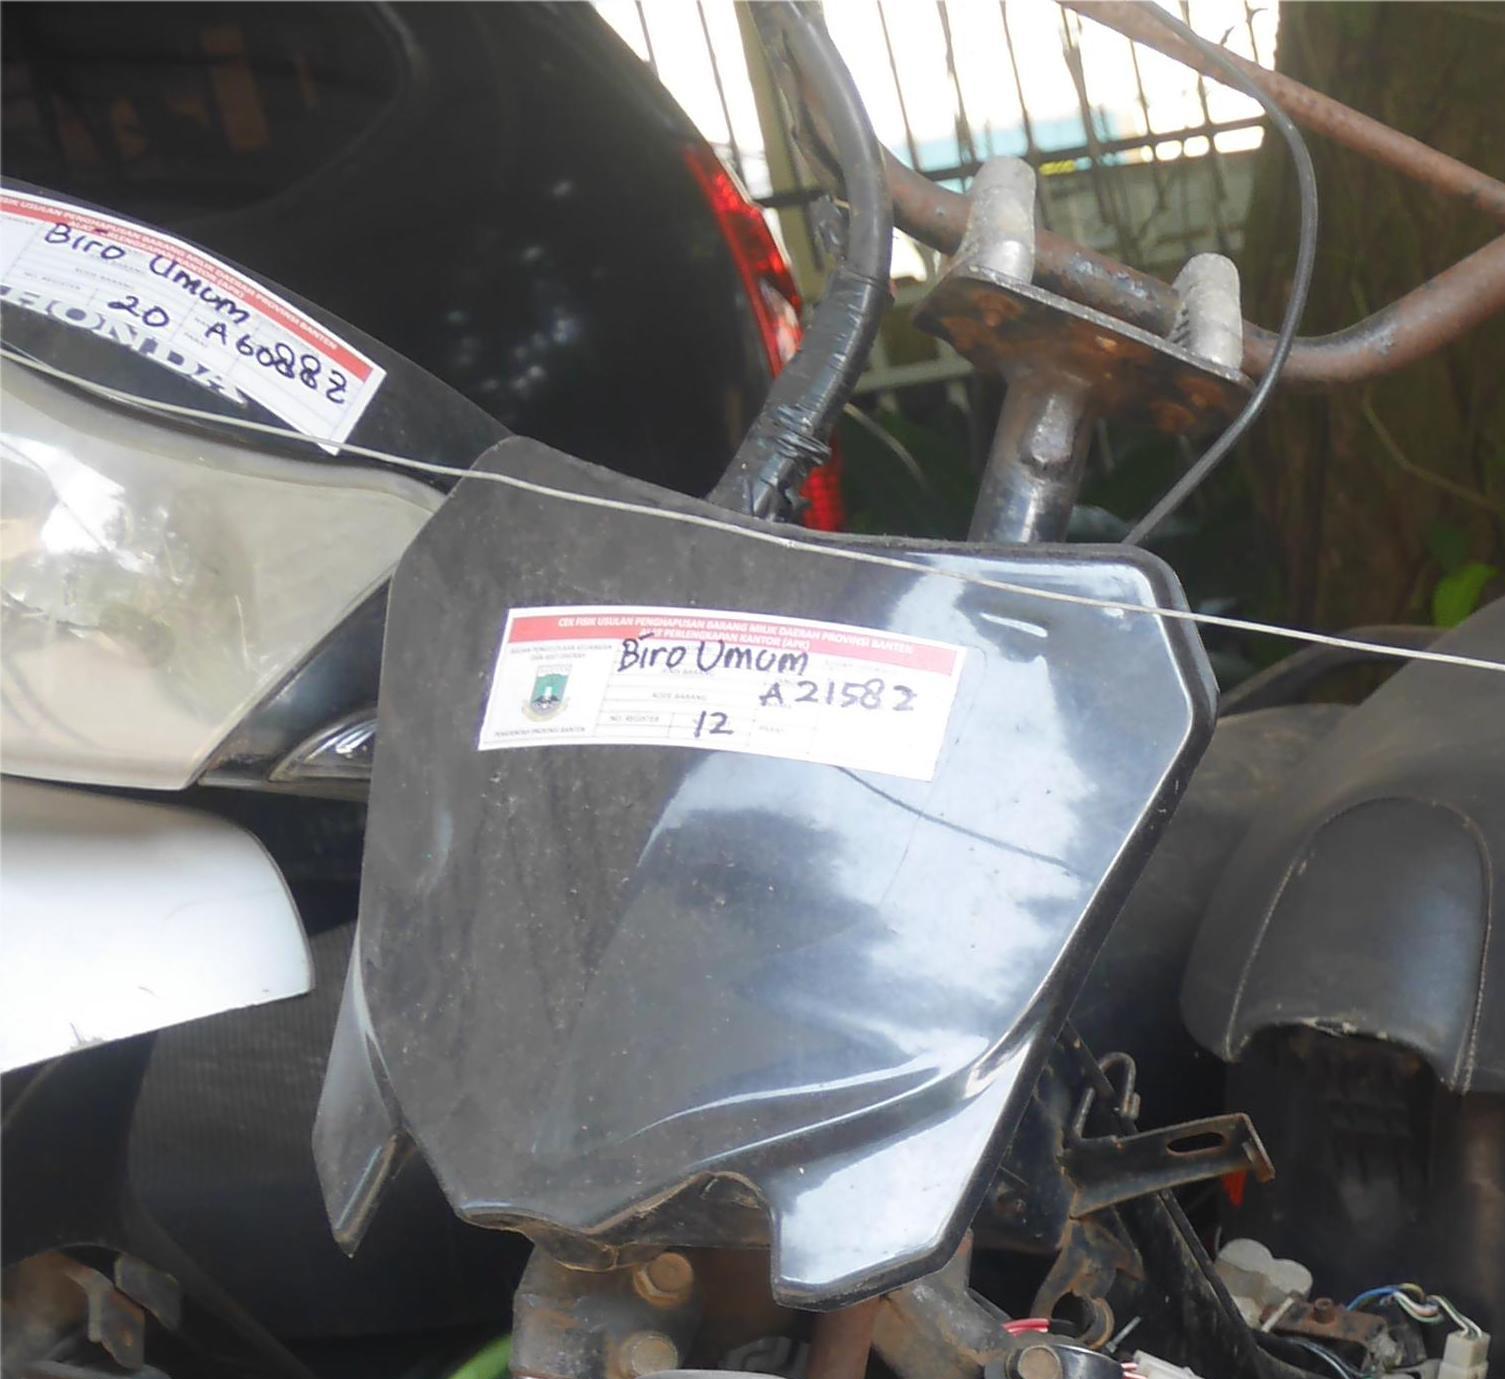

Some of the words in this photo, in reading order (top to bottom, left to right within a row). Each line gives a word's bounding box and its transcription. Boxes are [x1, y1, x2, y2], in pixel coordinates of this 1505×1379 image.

[45, 222, 125, 259] Biro
[107, 295, 169, 327] 20
[8, 284, 248, 405] HONDA
[597, 615, 634, 627] USULAN
[635, 615, 705, 630] PENGHAPUSAN
[617, 633, 687, 672] Biro
[697, 639, 808, 676] Umum
[694, 710, 734, 738] 12
